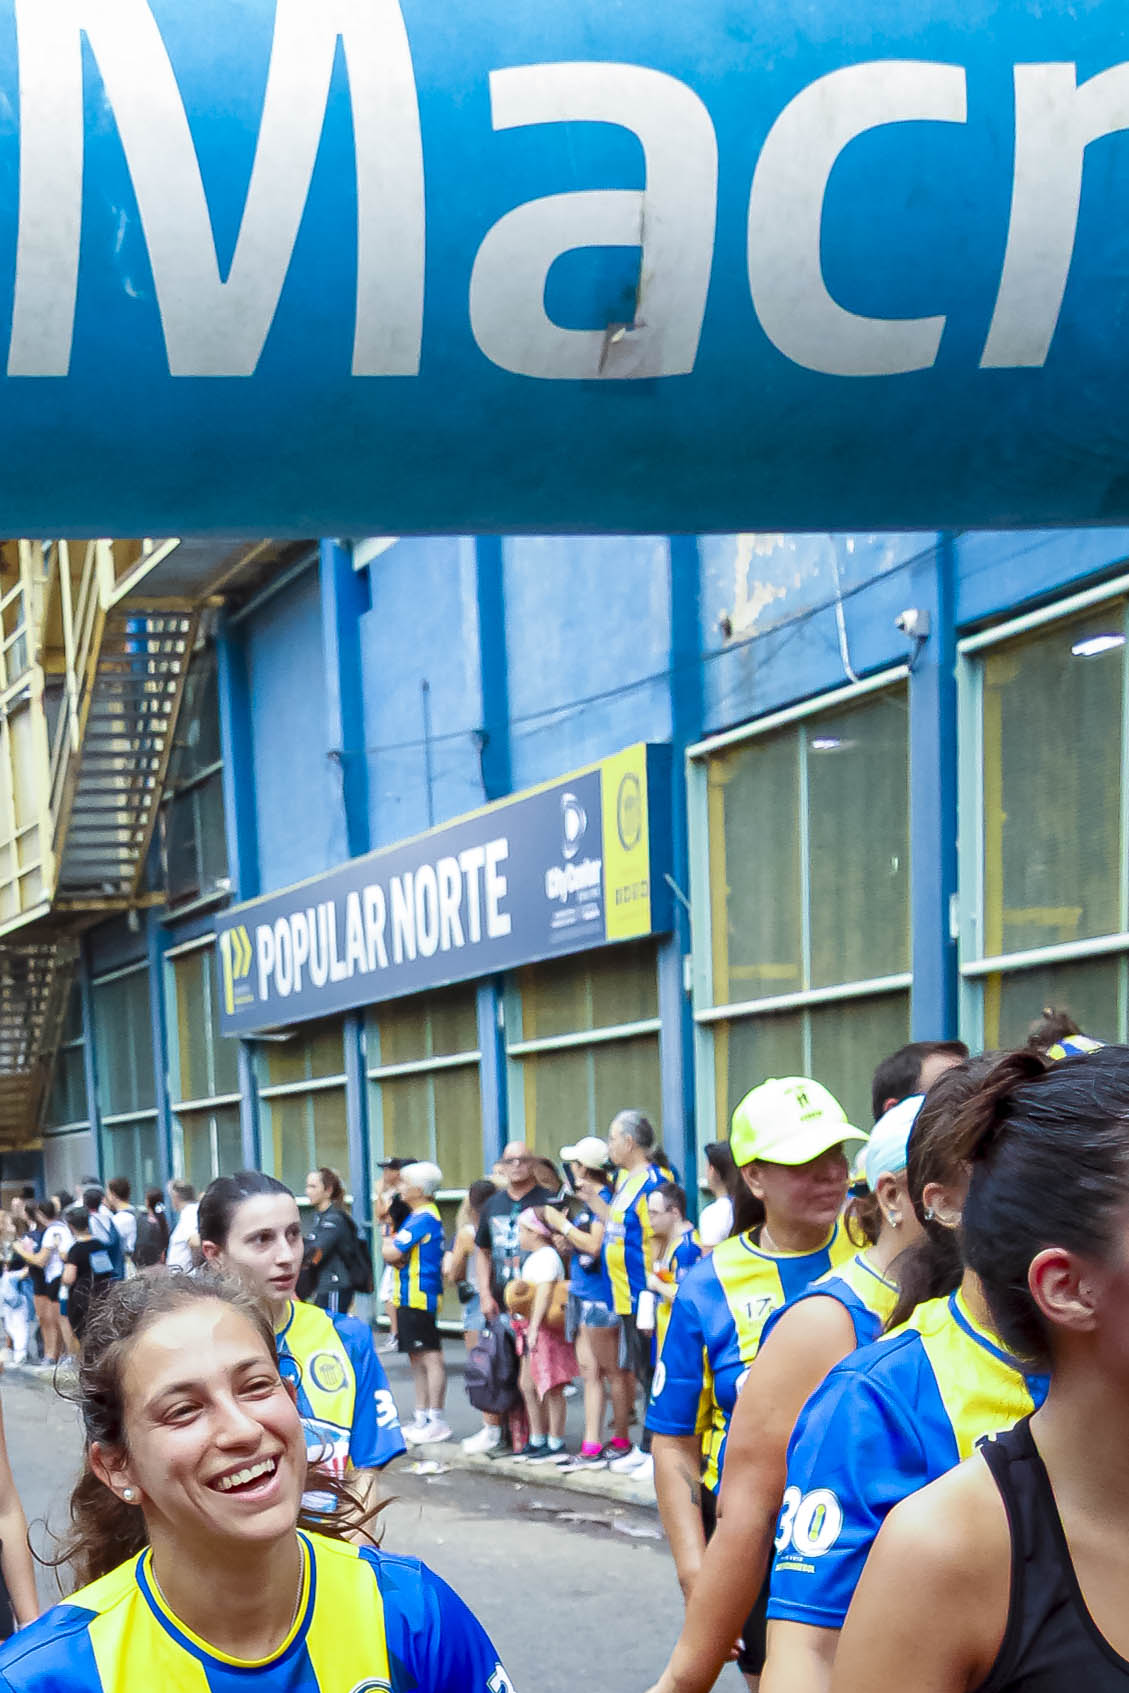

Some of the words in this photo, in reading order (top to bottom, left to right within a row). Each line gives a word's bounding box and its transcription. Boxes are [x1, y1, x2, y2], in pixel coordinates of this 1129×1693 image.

[255, 884, 388, 1001] POPULAR
[389, 837, 512, 965] NORTE
[745, 1297, 771, 1318] 17
[775, 1485, 844, 1557] 30
